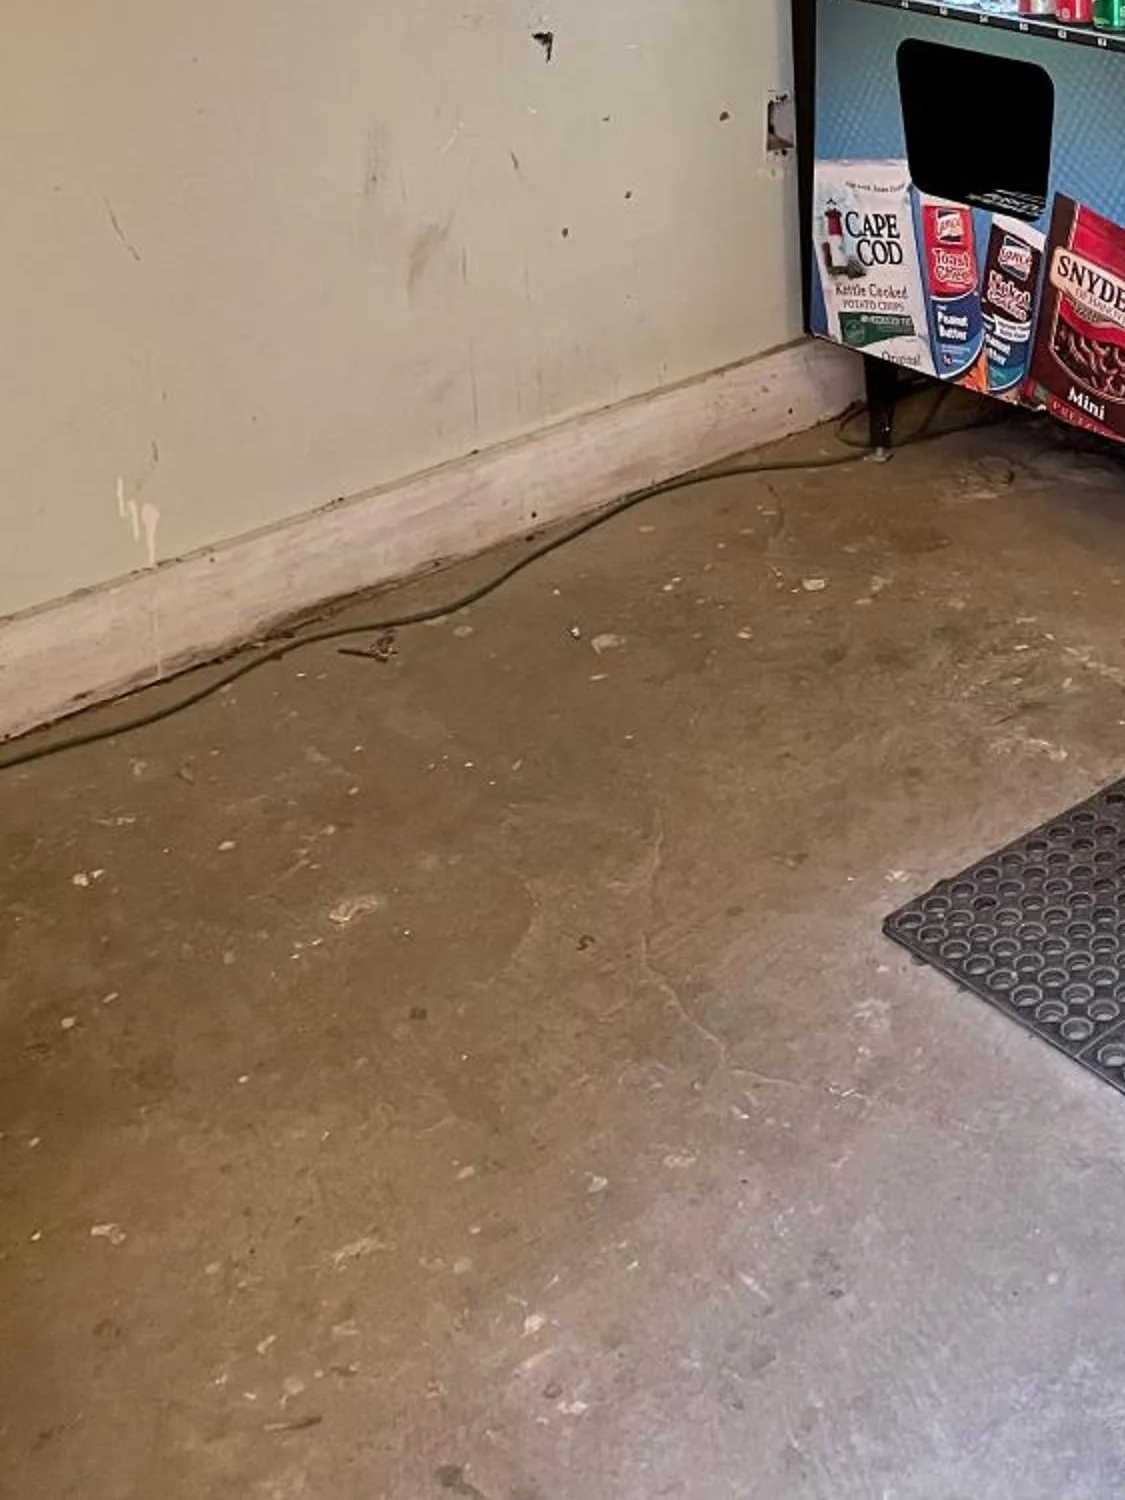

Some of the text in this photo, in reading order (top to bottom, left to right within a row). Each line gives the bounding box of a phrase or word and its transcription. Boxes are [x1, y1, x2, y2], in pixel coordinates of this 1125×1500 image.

[845, 211, 901, 239] CAPE
[856, 239, 904, 267] COD
[1067, 386, 1105, 421] Mini
